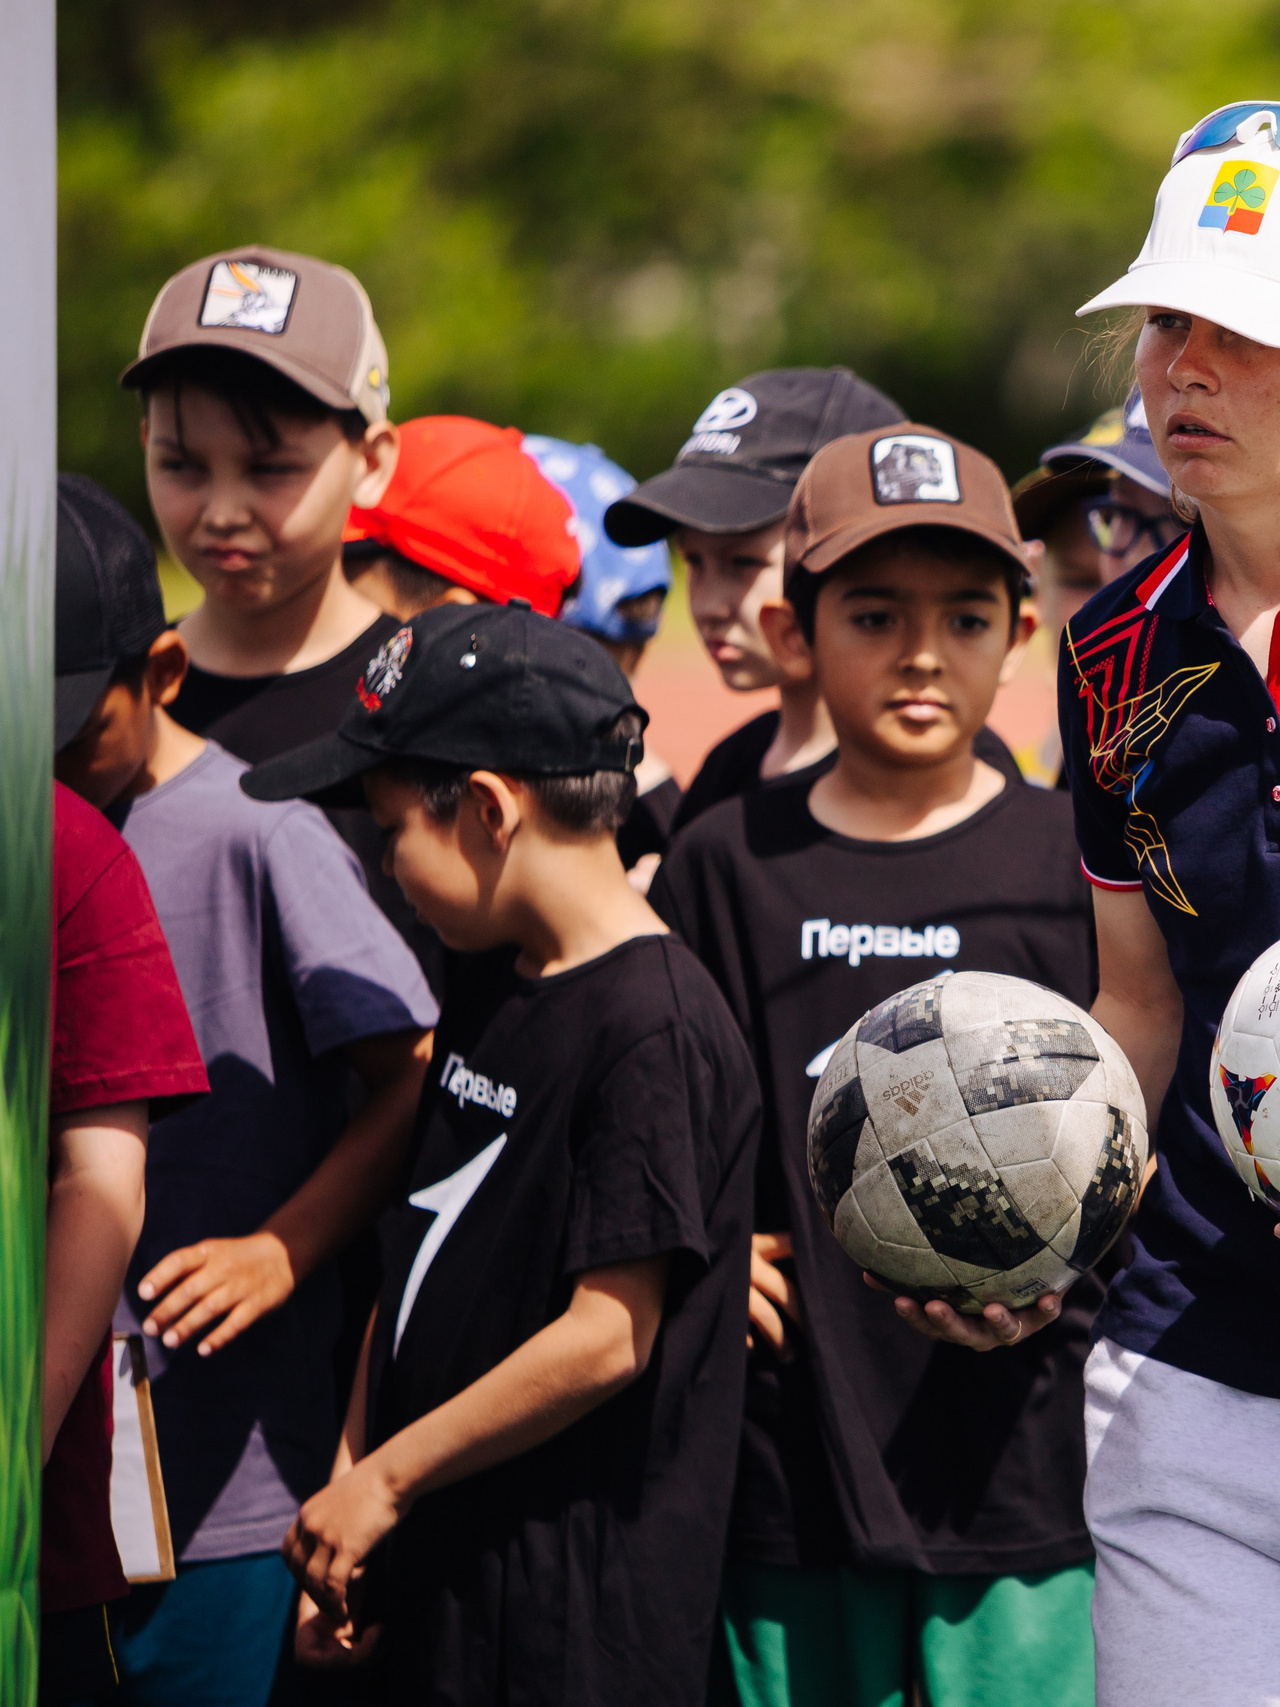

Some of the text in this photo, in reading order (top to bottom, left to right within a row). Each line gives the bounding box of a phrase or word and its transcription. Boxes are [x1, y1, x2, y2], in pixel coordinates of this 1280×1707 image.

[801, 917, 961, 967] Первые
[439, 1051, 518, 1118] Первые
[881, 1069, 935, 1102] adidas
